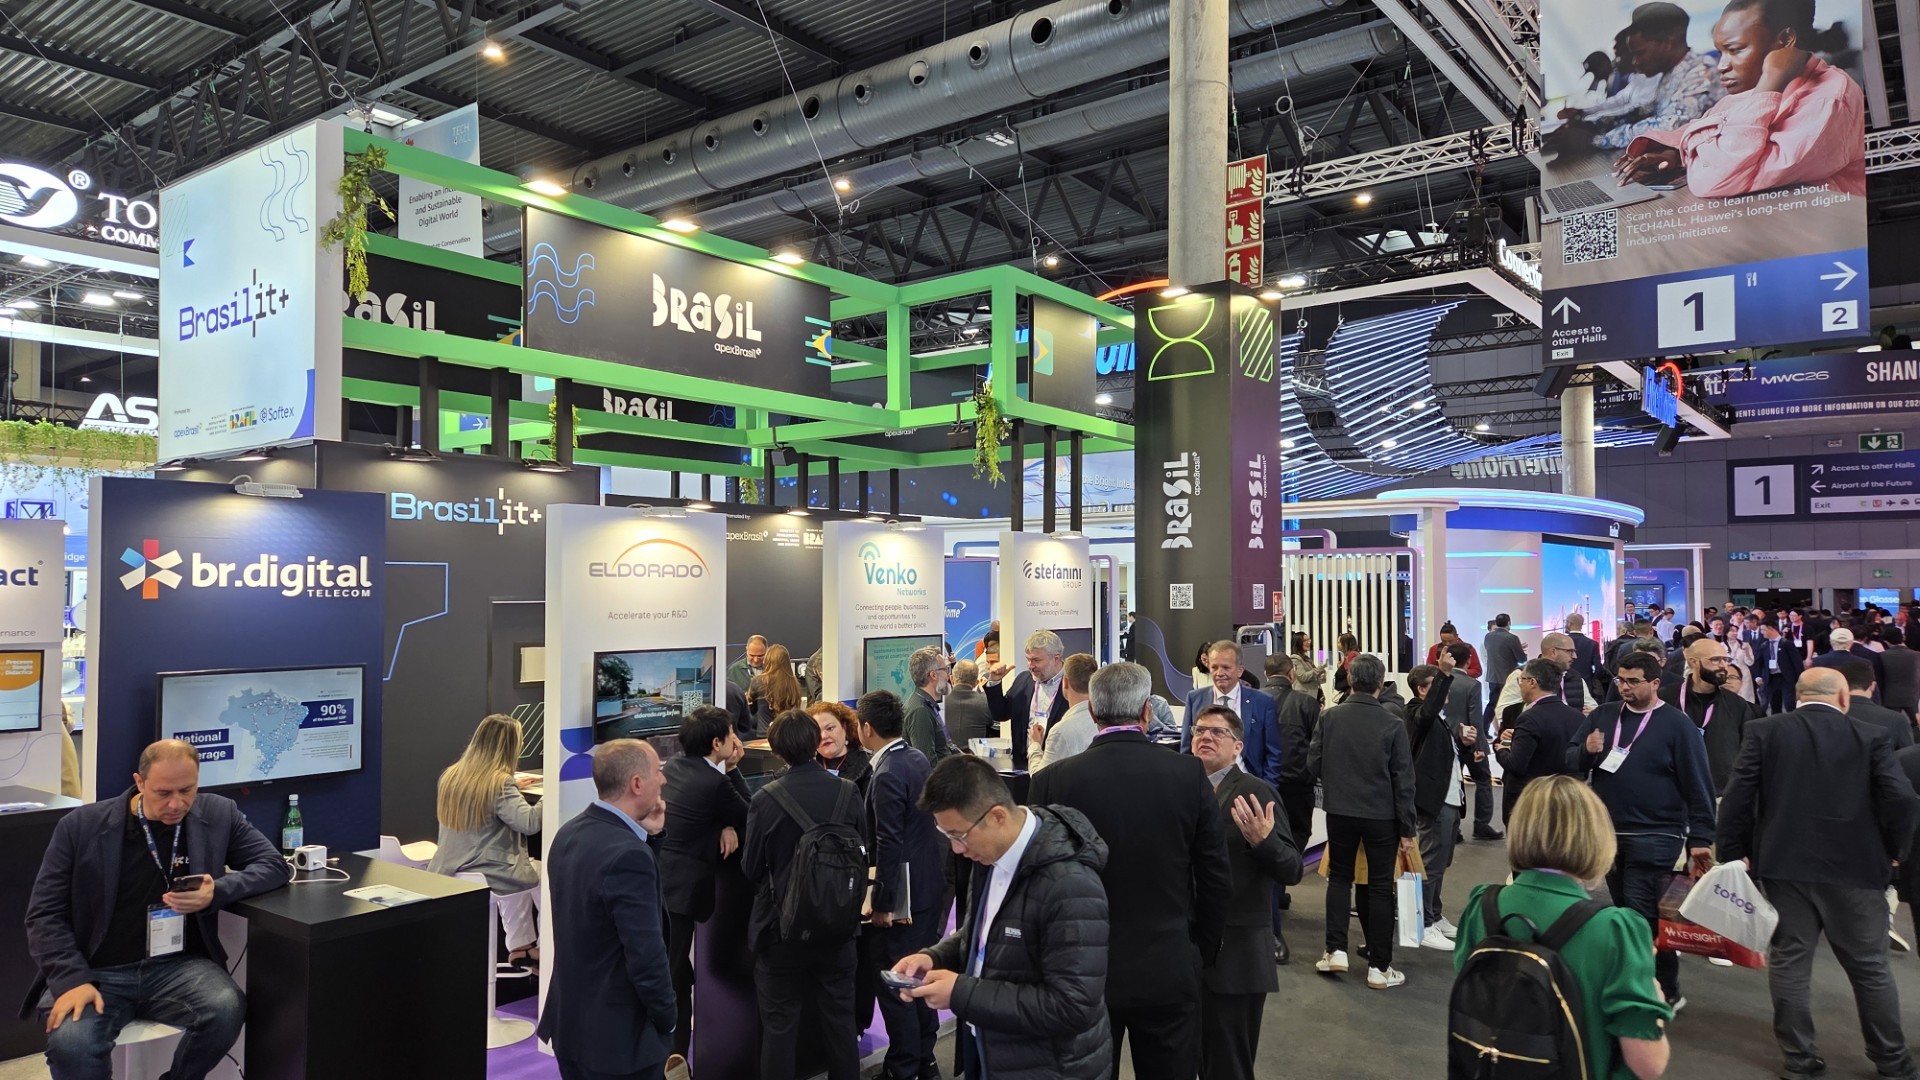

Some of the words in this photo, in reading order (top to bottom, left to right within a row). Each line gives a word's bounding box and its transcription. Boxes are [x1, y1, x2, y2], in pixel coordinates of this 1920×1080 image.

[409, 189, 433, 204] Enabling
[434, 189, 442, 197] an
[415, 205, 426, 215] and
[427, 195, 462, 212] Sustainable
[1626, 211, 1651, 223] Scan
[1656, 208, 1673, 218] the
[1677, 203, 1704, 214] code
[1708, 200, 1720, 209] to
[1724, 196, 1754, 207] learn
[1758, 189, 1789, 200] more
[1793, 183, 1830, 196] about
[1690, 209, 1743, 225] Huawei's
[1747, 200, 1807, 217] long-term
[1811, 192, 1851, 208] digital
[418, 213, 438, 228] Digital
[439, 209, 459, 222] World
[441, 236, 471, 248] Conservation
[1626, 232, 1675, 247] inclusion
[1678, 224, 1731, 239] initiative.
[1684, 291, 1704, 331] 1
[1833, 307, 1847, 325] 2
[1552, 327, 1589, 338] Access
[1591, 325, 1602, 333] to
[1552, 337, 1579, 347] other
[1581, 333, 1607, 343] Halls
[714, 342, 758, 359] apexBrasil
[1761, 371, 1830, 385] MWC26
[1866, 360, 1920, 383] SHAN
[268, 406, 295, 422] Softex
[1757, 407, 1785, 416] LOUNGE
[1786, 405, 1800, 413] FOR
[1802, 404, 1822, 412] MORE
[1824, 401, 1873, 411] INFORMATION
[1875, 401, 1886, 409] ON
[1888, 400, 1903, 408] OUR
[1905, 399, 1920, 407] 202
[1830, 464, 1860, 472] Access
[1871, 462, 1893, 470] other
[1895, 461, 1915, 469] Halls
[1193, 456, 1201, 496] apexBrasil
[1754, 475, 1770, 505] 1
[1831, 482, 1859, 490] Airport
[192, 552, 373, 597] br.digital
[588, 562, 703, 578] ELDORADO
[864, 562, 917, 585] Venko
[1035, 563, 1082, 580] stefanini
[307, 589, 371, 597] TELECOM
[897, 588, 927, 596] Networks
[608, 611, 650, 620] Accelerate
[653, 612, 669, 620] your
[671, 610, 688, 618] R&D
[855, 604, 884, 612] Connecting
[1060, 609, 1079, 617] Consulting
[320, 703, 346, 716] 90%
[1713, 883, 1756, 914] totog
[1677, 930, 1722, 944] KEYSIGHT
